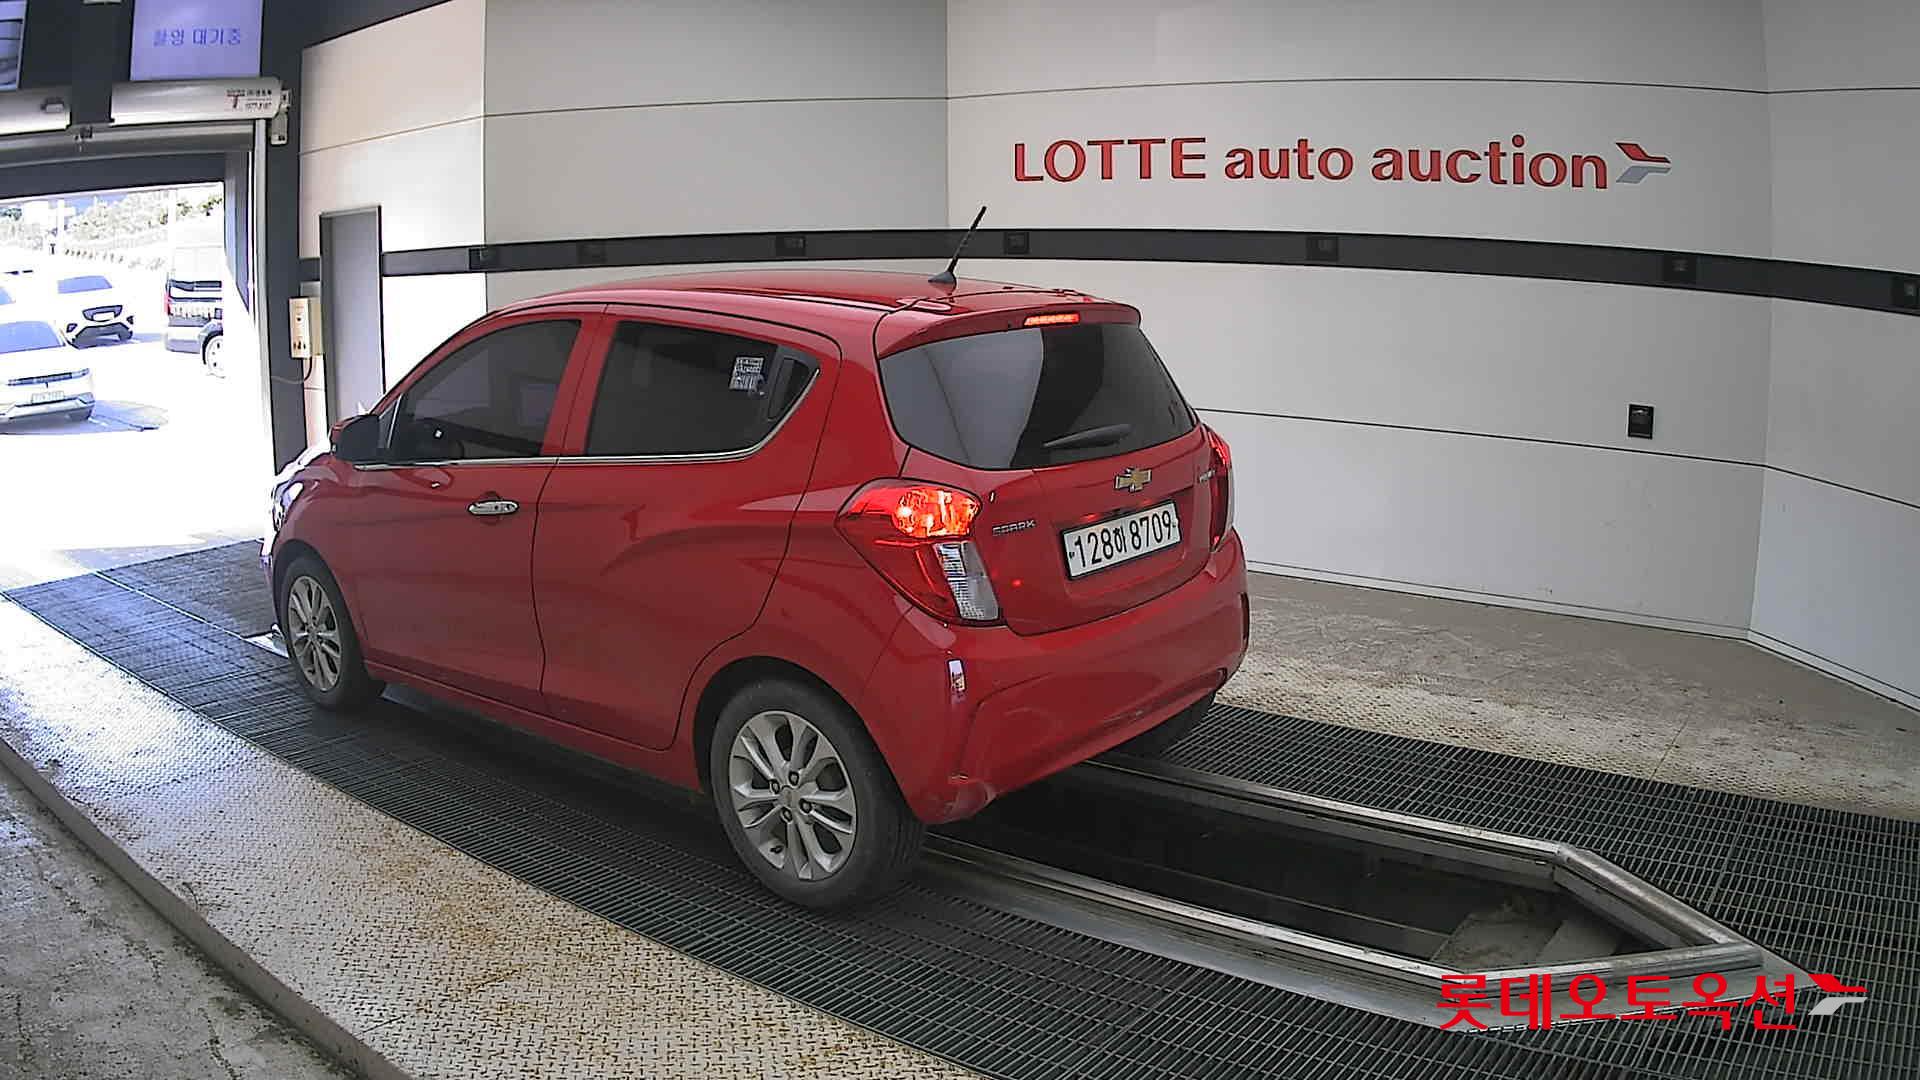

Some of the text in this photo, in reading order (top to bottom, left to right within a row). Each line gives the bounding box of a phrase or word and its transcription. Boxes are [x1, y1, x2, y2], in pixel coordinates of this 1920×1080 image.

[1013, 134, 1608, 189] LOTTE auto auction
